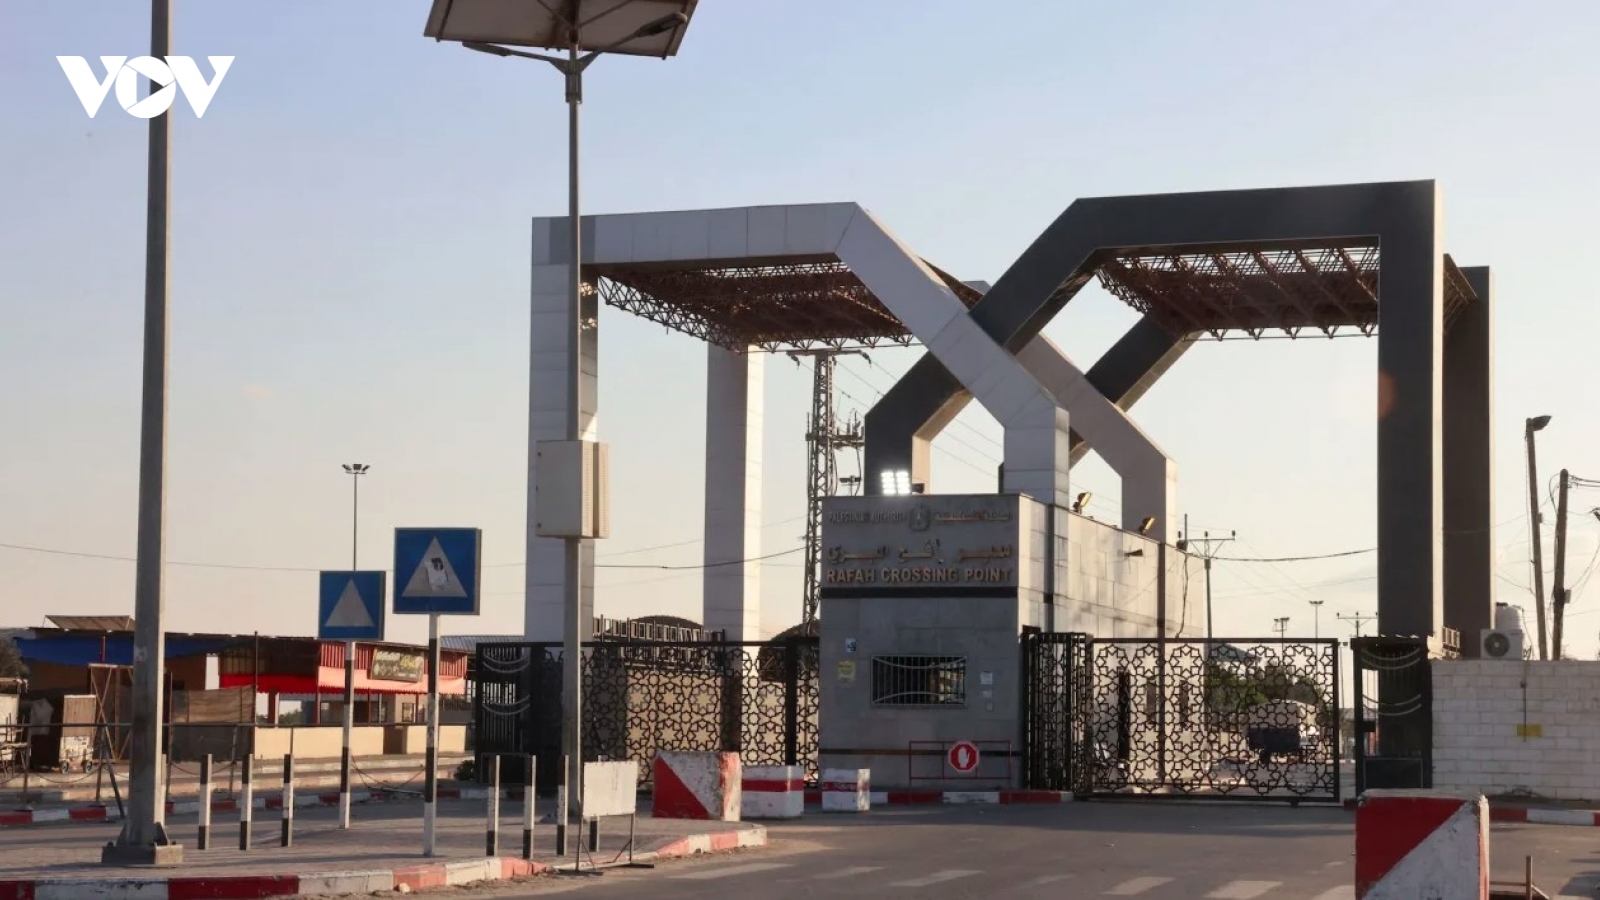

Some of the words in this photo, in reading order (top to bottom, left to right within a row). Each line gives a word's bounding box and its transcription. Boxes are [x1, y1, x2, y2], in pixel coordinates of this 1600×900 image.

[827, 568, 875, 583] RAFAH
[881, 567, 958, 583] CROSSING
[964, 567, 1011, 582] POINT
